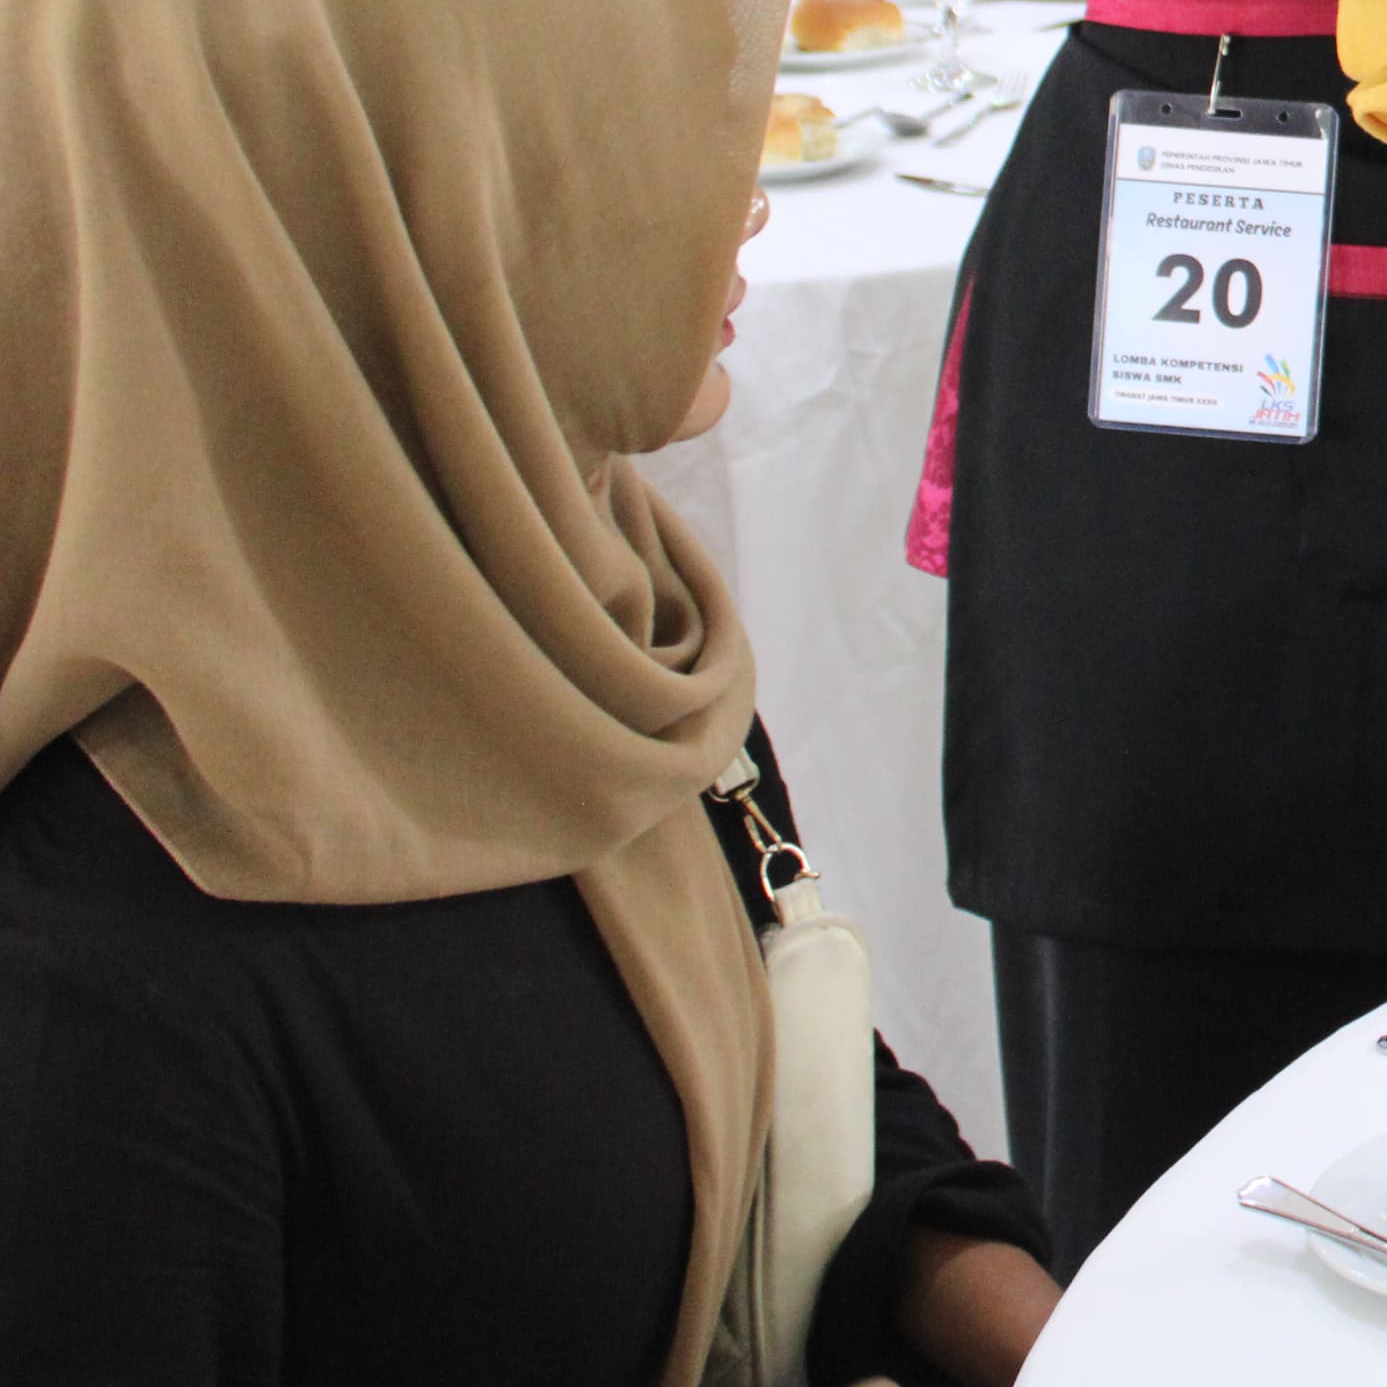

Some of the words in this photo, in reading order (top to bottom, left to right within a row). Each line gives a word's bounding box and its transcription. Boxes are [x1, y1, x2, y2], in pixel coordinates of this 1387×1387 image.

[1253, 158, 1277, 167] JAWA
[1173, 191, 1264, 210] PESERTA
[1146, 212, 1233, 233] Restaurant
[1235, 219, 1292, 238] Service
[1152, 253, 1263, 329] 20
[1113, 353, 1156, 366] LOMBA
[1160, 357, 1244, 373] KOMPETENSI
[1112, 370, 1151, 382] SISWA
[1155, 373, 1182, 384] SMK
[1260, 399, 1295, 411] LKS
